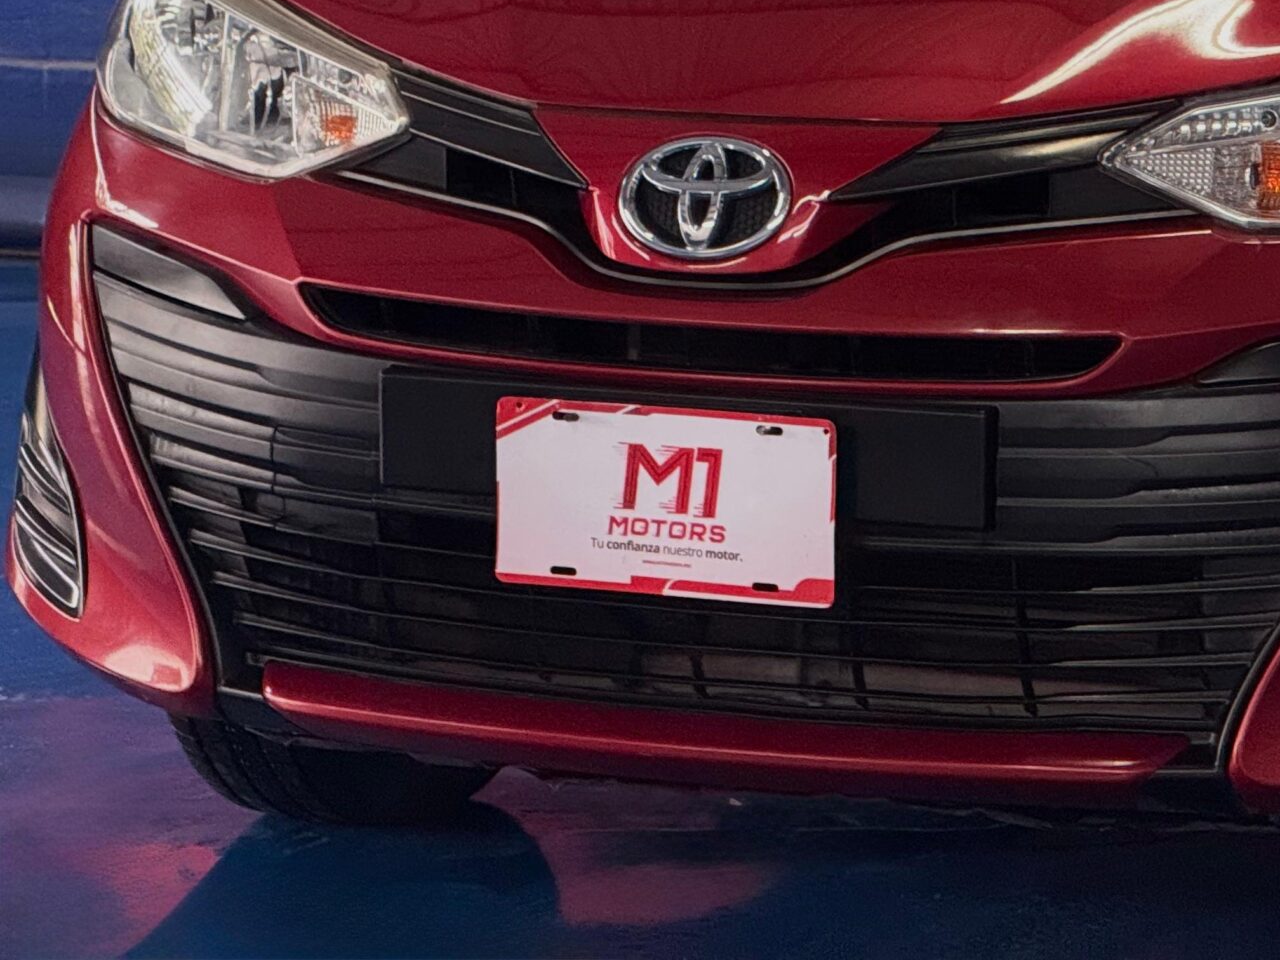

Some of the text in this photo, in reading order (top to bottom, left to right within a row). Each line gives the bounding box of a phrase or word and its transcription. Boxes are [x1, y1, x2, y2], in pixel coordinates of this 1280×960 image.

[614, 442, 723, 519] M1
[608, 515, 726, 543] MOTORS
[591, 537, 743, 562] Tu confianza nuestro motor.
